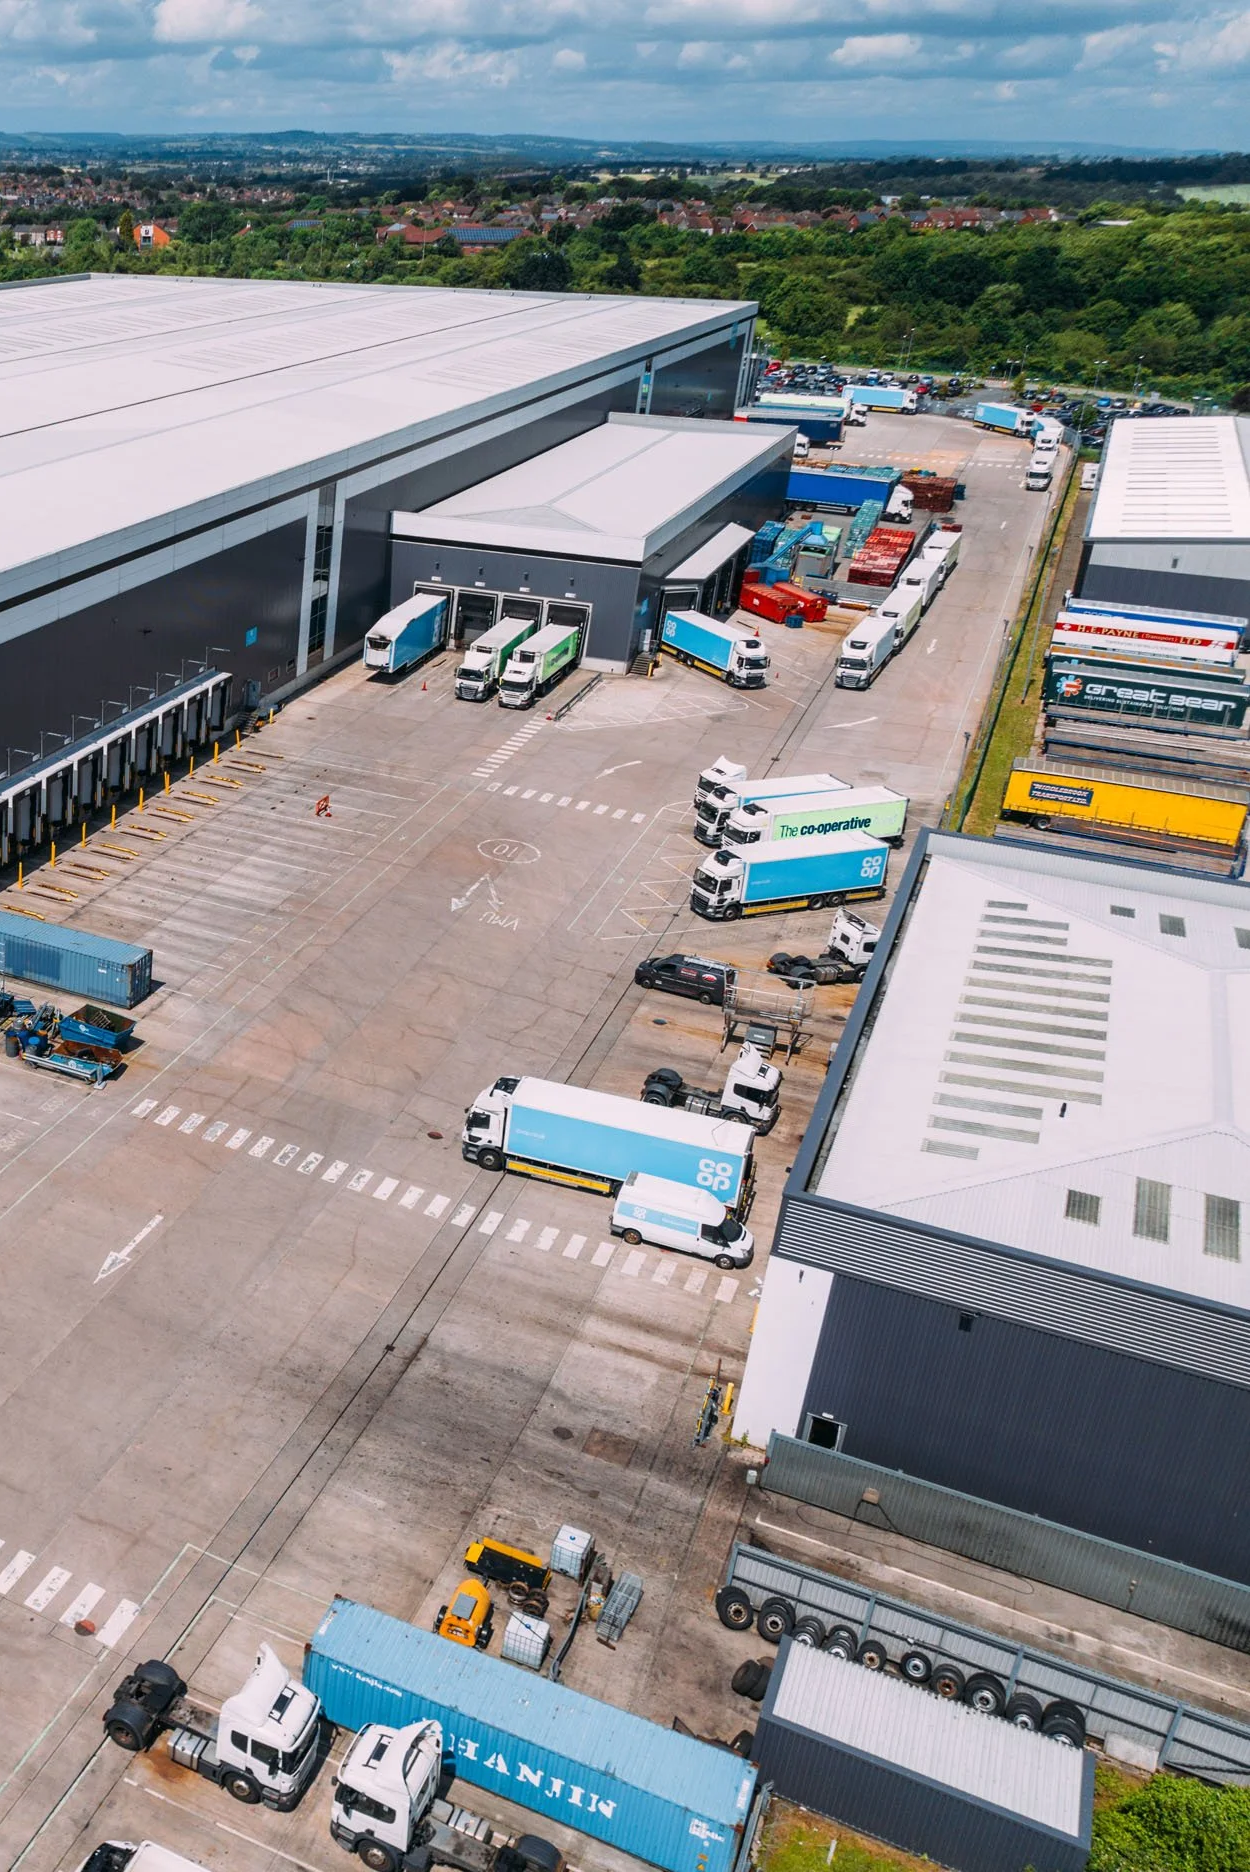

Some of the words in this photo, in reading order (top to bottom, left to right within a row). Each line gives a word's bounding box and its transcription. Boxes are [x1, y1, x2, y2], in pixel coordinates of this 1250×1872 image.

[1179, 637, 1202, 646] LTD
[1085, 683, 1166, 703] Great
[1169, 694, 1238, 711] Bear
[1154, 704, 1184, 712] OLUIONS
[780, 824, 799, 838] The
[800, 816, 871, 837] co-operative
[493, 844, 519, 857] 10
[479, 911, 519, 931] VMU
[448, 1733, 618, 1819] HANJIN
